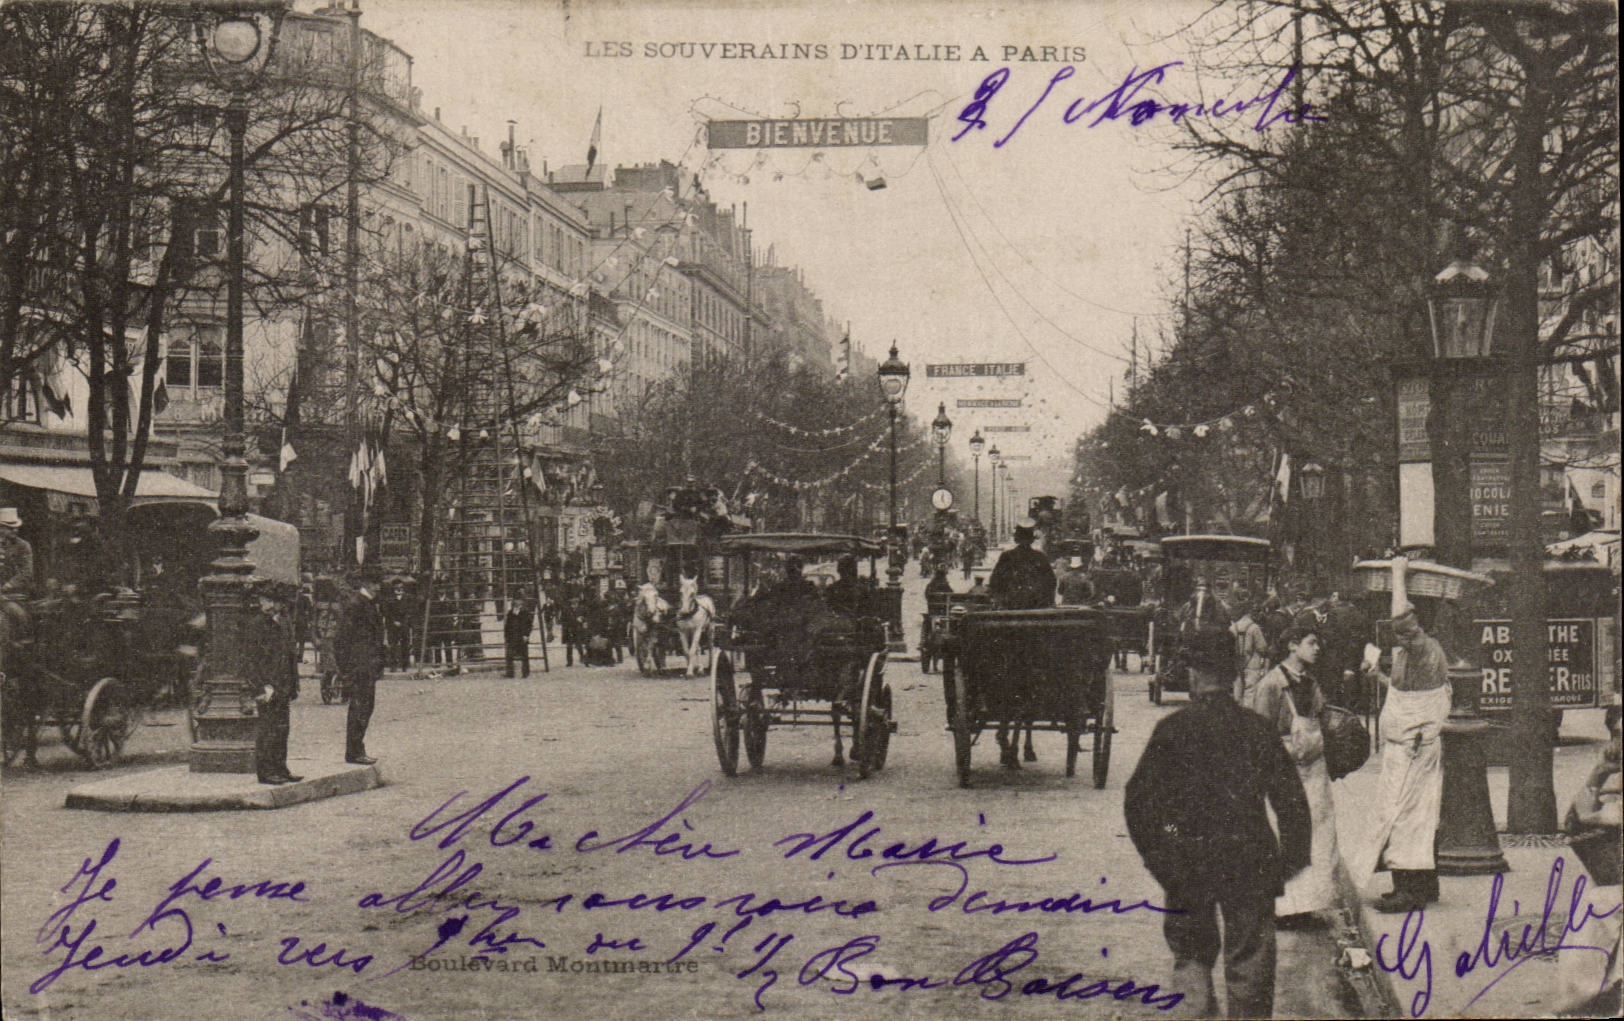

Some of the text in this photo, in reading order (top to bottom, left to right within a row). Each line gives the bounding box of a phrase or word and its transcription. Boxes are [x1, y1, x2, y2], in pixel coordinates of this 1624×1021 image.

[746, 119, 895, 146] BIENVENUE
[934, 363, 1020, 376] FRANCE ITALIE
[1473, 504, 1510, 517] ENIE
[1481, 625, 1579, 645] ABTHE
[1571, 673, 1592, 691] FILS
[1480, 696, 1513, 705] EXIGE
[777, 810, 1058, 867] Marie
[36, 838, 121, 945] Je
